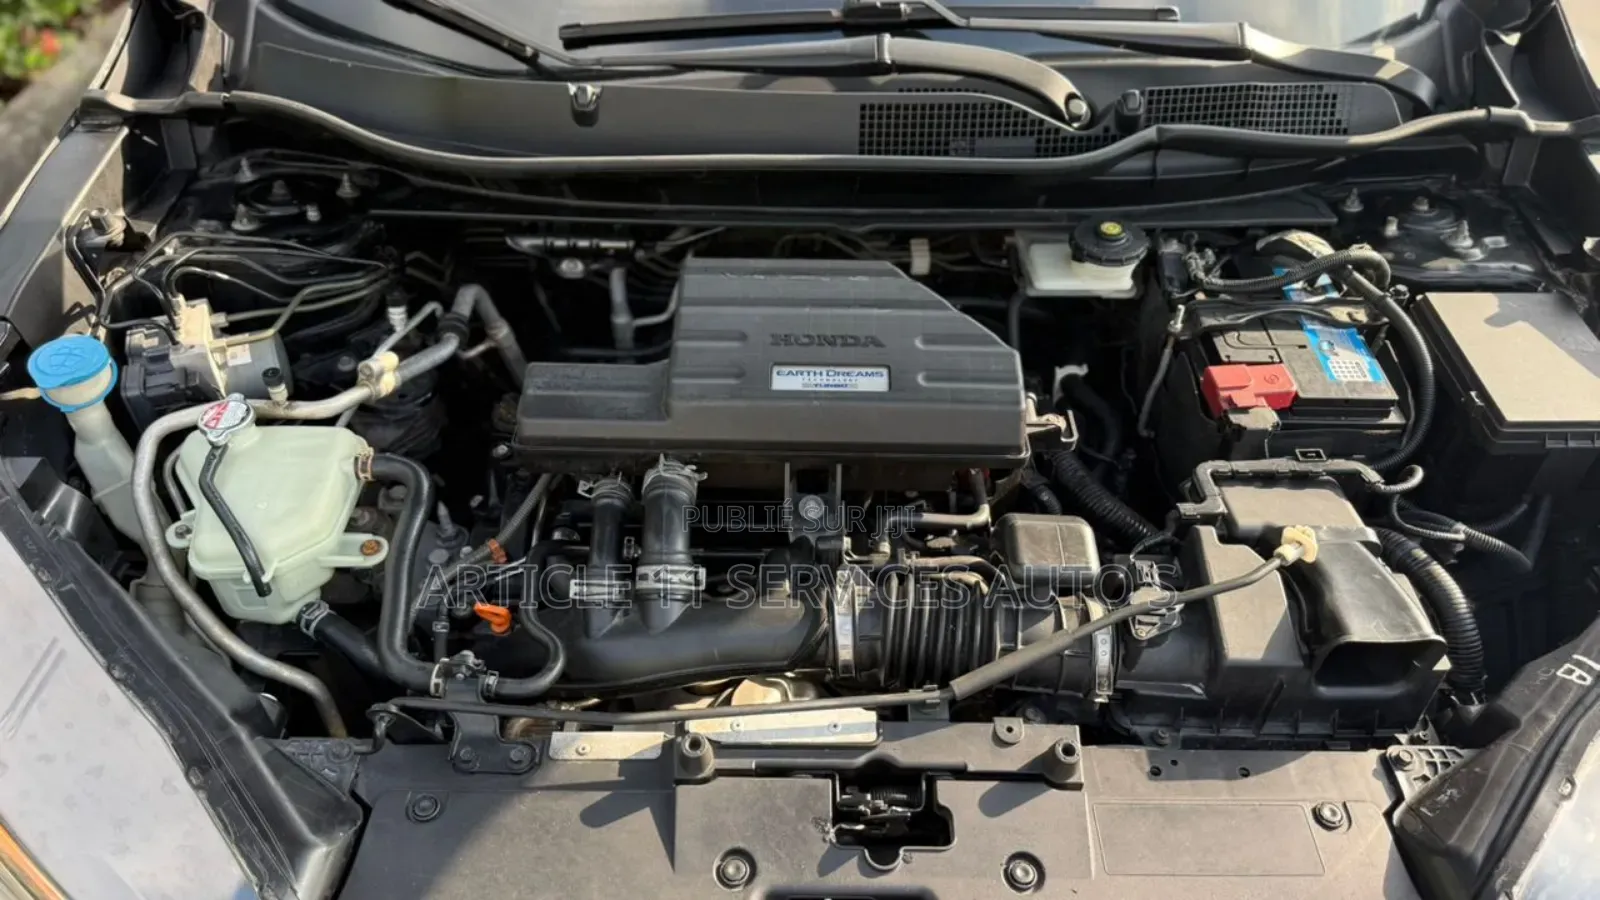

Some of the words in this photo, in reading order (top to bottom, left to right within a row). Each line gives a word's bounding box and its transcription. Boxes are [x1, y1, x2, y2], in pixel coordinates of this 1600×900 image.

[769, 334, 886, 348] HONDA
[776, 369, 823, 377] EARTH
[825, 368, 884, 378] DREAMS
